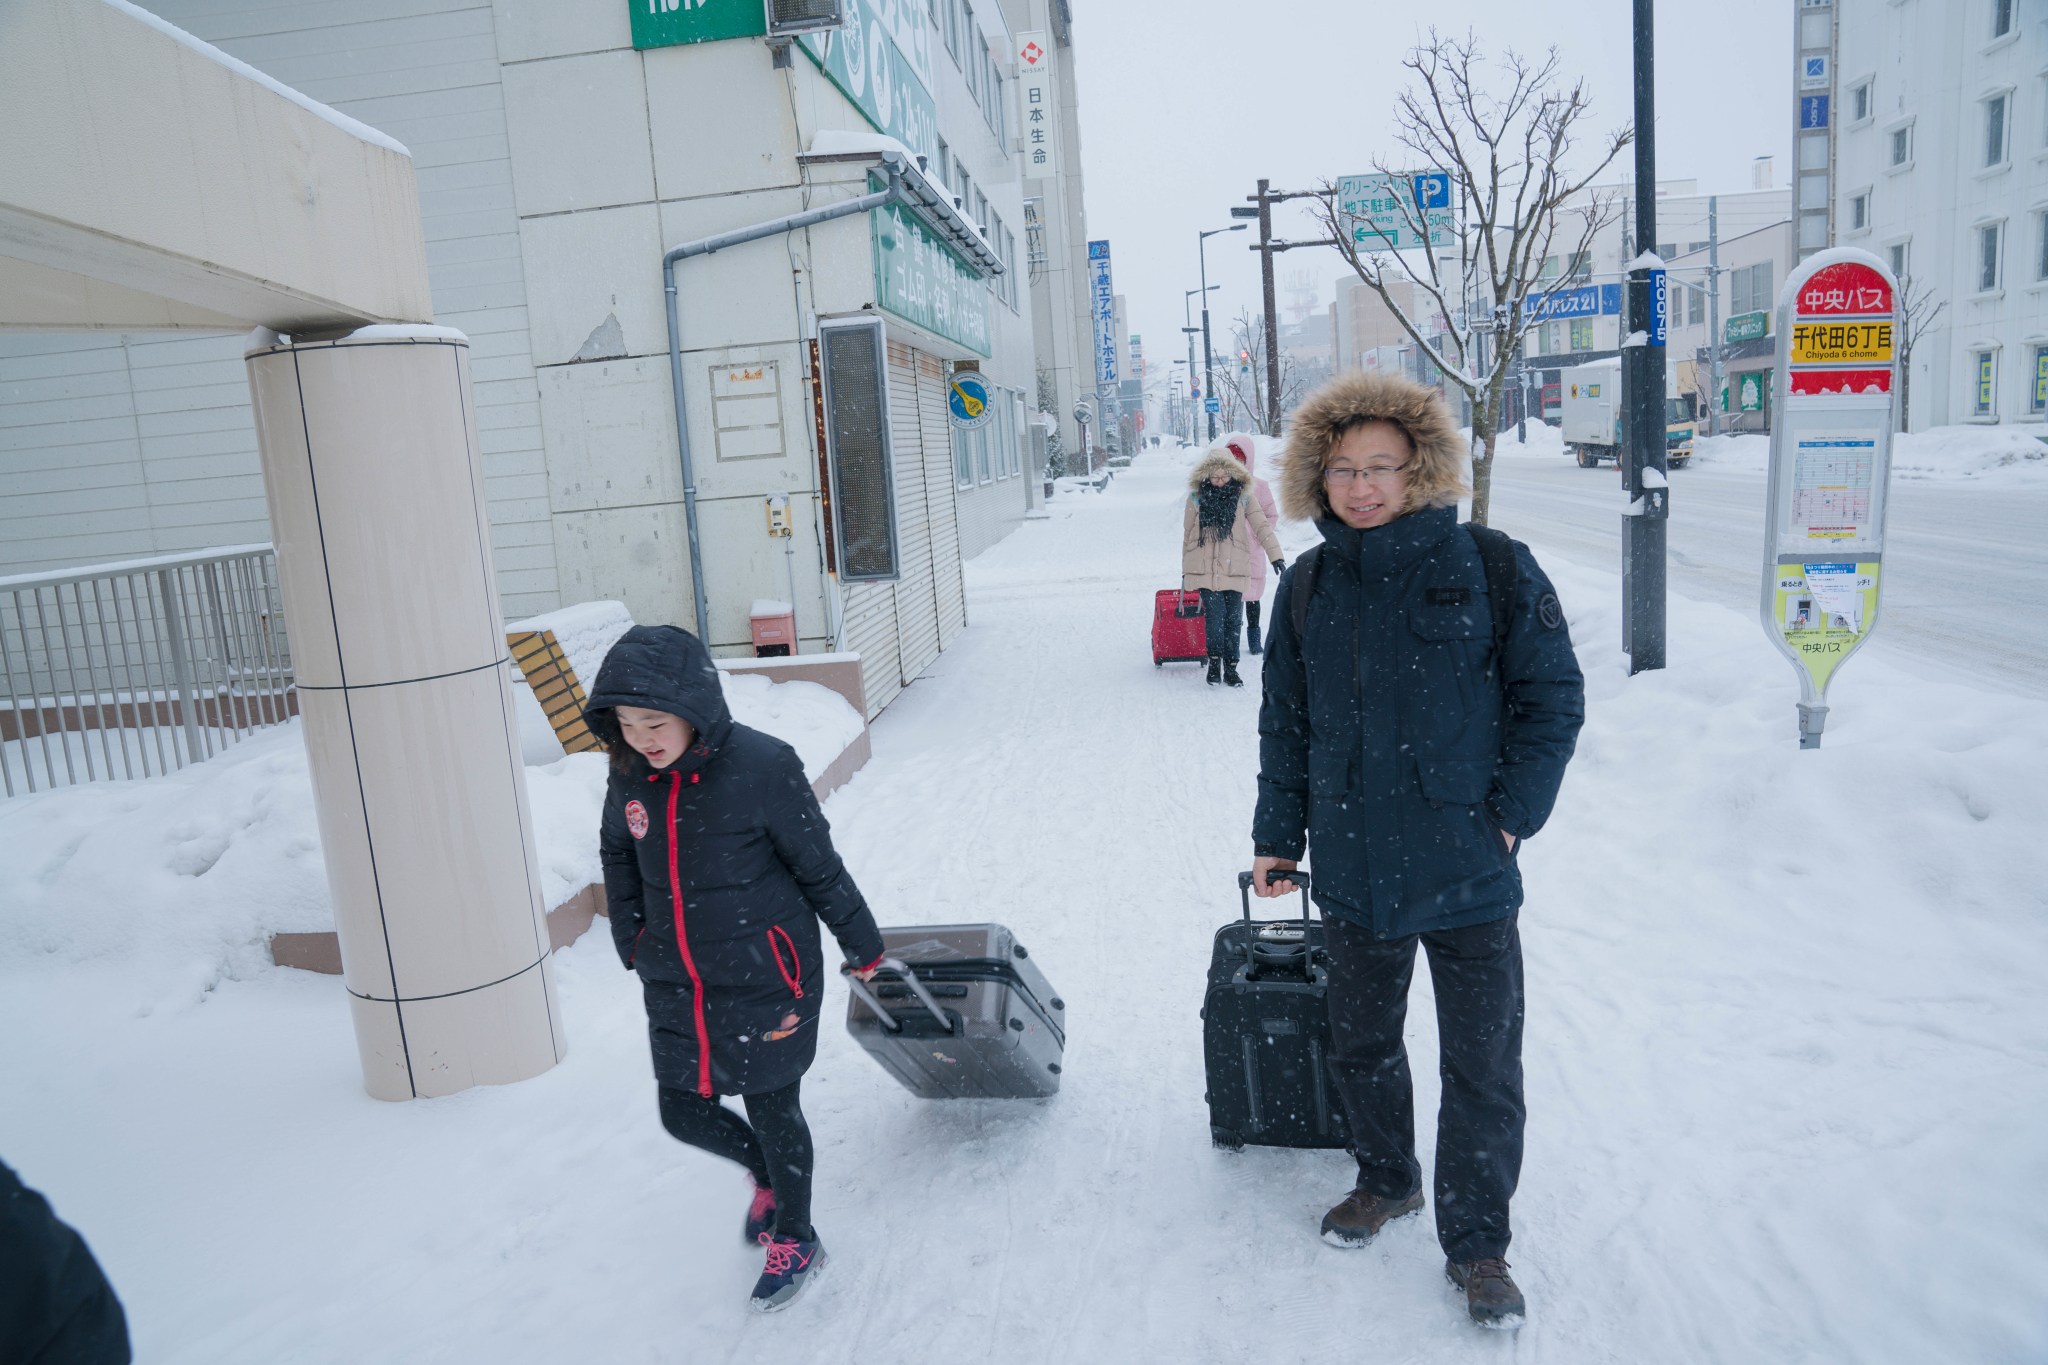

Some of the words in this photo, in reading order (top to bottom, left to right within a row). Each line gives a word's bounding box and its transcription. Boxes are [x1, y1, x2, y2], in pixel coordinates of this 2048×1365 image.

[1021, 66, 1045, 74] NISSAY
[1028, 87, 1047, 164] 日本生命
[1805, 288, 1884, 311] 中央バス
[1096, 261, 1116, 381] 千歳エアポートホテル
[1094, 319, 1102, 354] AIRPORT
[1794, 325, 1892, 350] 千代田6丁目
[1805, 350, 1840, 360] Chiyoda
[1841, 350, 1848, 358] 6
[1849, 350, 1878, 358] chome
[1802, 642, 1841, 653] 中央バス
